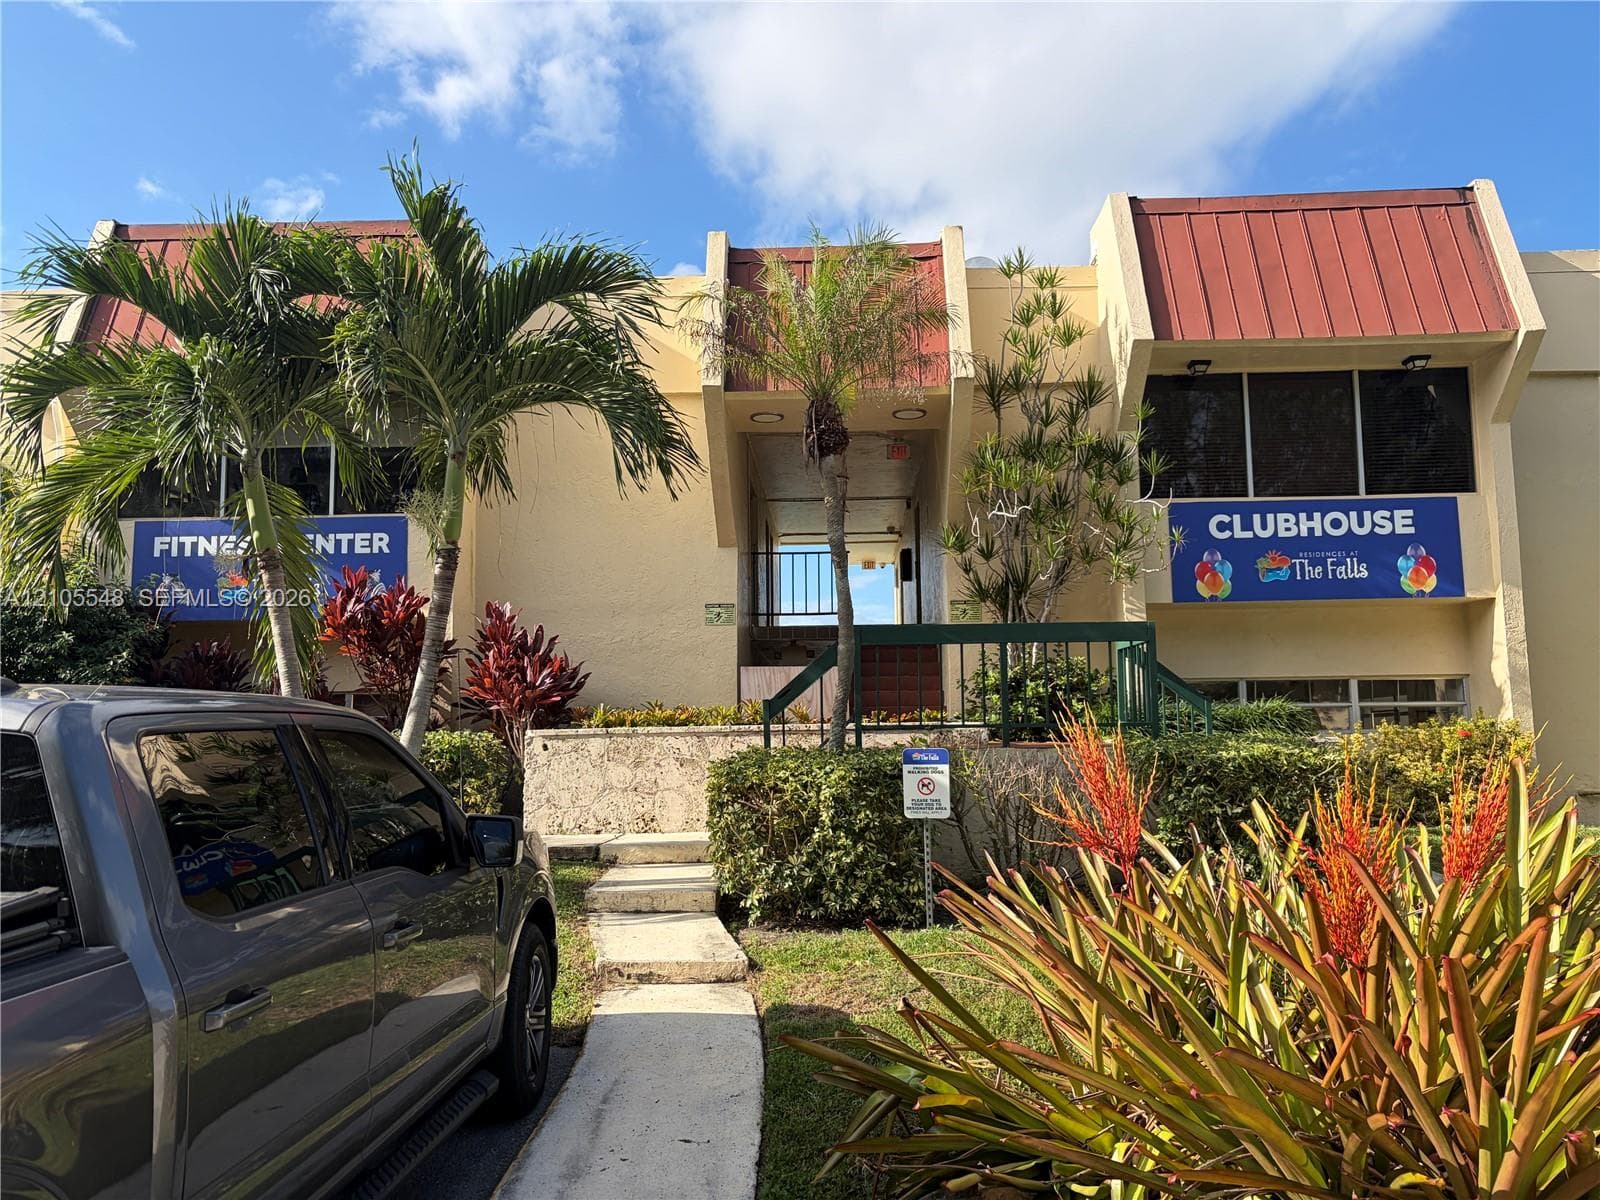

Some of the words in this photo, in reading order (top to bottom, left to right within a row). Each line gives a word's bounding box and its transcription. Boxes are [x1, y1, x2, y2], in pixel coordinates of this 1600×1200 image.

[1208, 509, 1416, 539] CLUBHOUSE
[153, 535, 253, 557] FITNES
[304, 532, 391, 554] NTER
[1291, 558, 1323, 580] The
[1326, 557, 1369, 580] Falls
